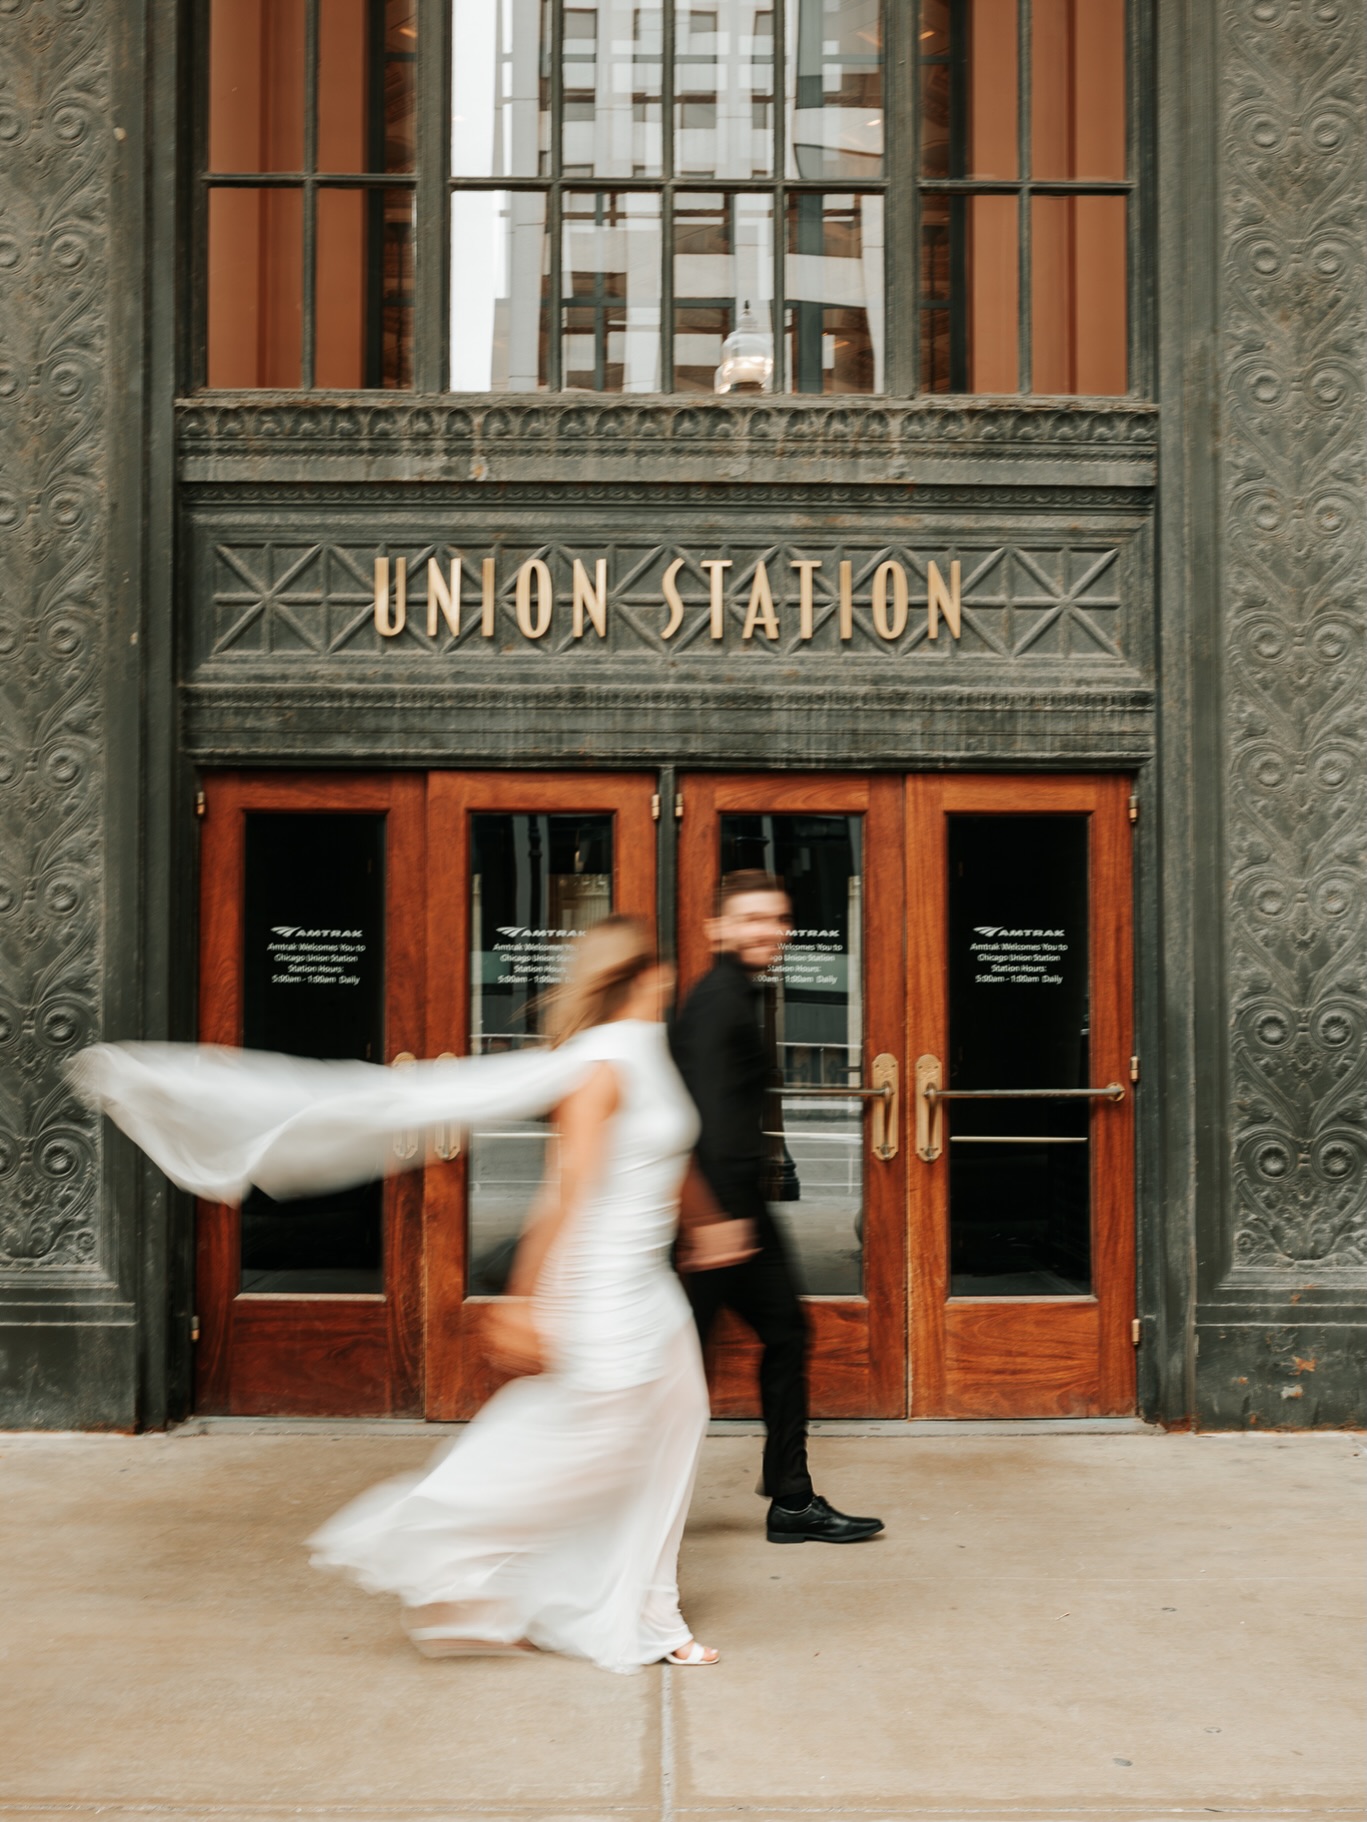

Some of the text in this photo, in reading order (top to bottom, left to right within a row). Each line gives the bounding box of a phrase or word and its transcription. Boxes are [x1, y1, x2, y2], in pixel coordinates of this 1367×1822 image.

[374, 556, 962, 640] UNION STATION
[295, 929, 363, 938] AMTRAK
[520, 929, 587, 938] AMTRAK
[776, 929, 840, 938] AMTRAK
[997, 929, 1066, 938] AMTRAK
[267, 942, 367, 953] Amtrak Welcomes You to
[492, 942, 523, 952] Amtrak
[524, 942, 564, 952] Welcomes
[777, 942, 844, 952] Welcomes You to
[970, 942, 1069, 952] Amtrak Welcomes You to
[274, 953, 359, 964] Chicago Union Station
[500, 953, 532, 964] Chicago
[532, 953, 555, 963] Union
[784, 953, 808, 963] Union
[807, 953, 836, 963] Station
[977, 953, 1061, 964] Chicago Union Station
[287, 963, 345, 974] Station Hours:
[513, 964, 543, 974] Station
[767, 963, 822, 973] Station Hours:
[991, 963, 1048, 973] Station Hours:
[271, 974, 302, 984] 5:00am
[307, 974, 337, 984] 1:00am
[338, 975, 361, 986] Daily
[497, 974, 528, 984] 5:00am
[785, 974, 814, 984] 1:00am
[816, 974, 838, 985] Daily
[975, 974, 1005, 984] 5:00am
[1010, 974, 1040, 984] 1:00am
[1041, 974, 1064, 985] Daily
